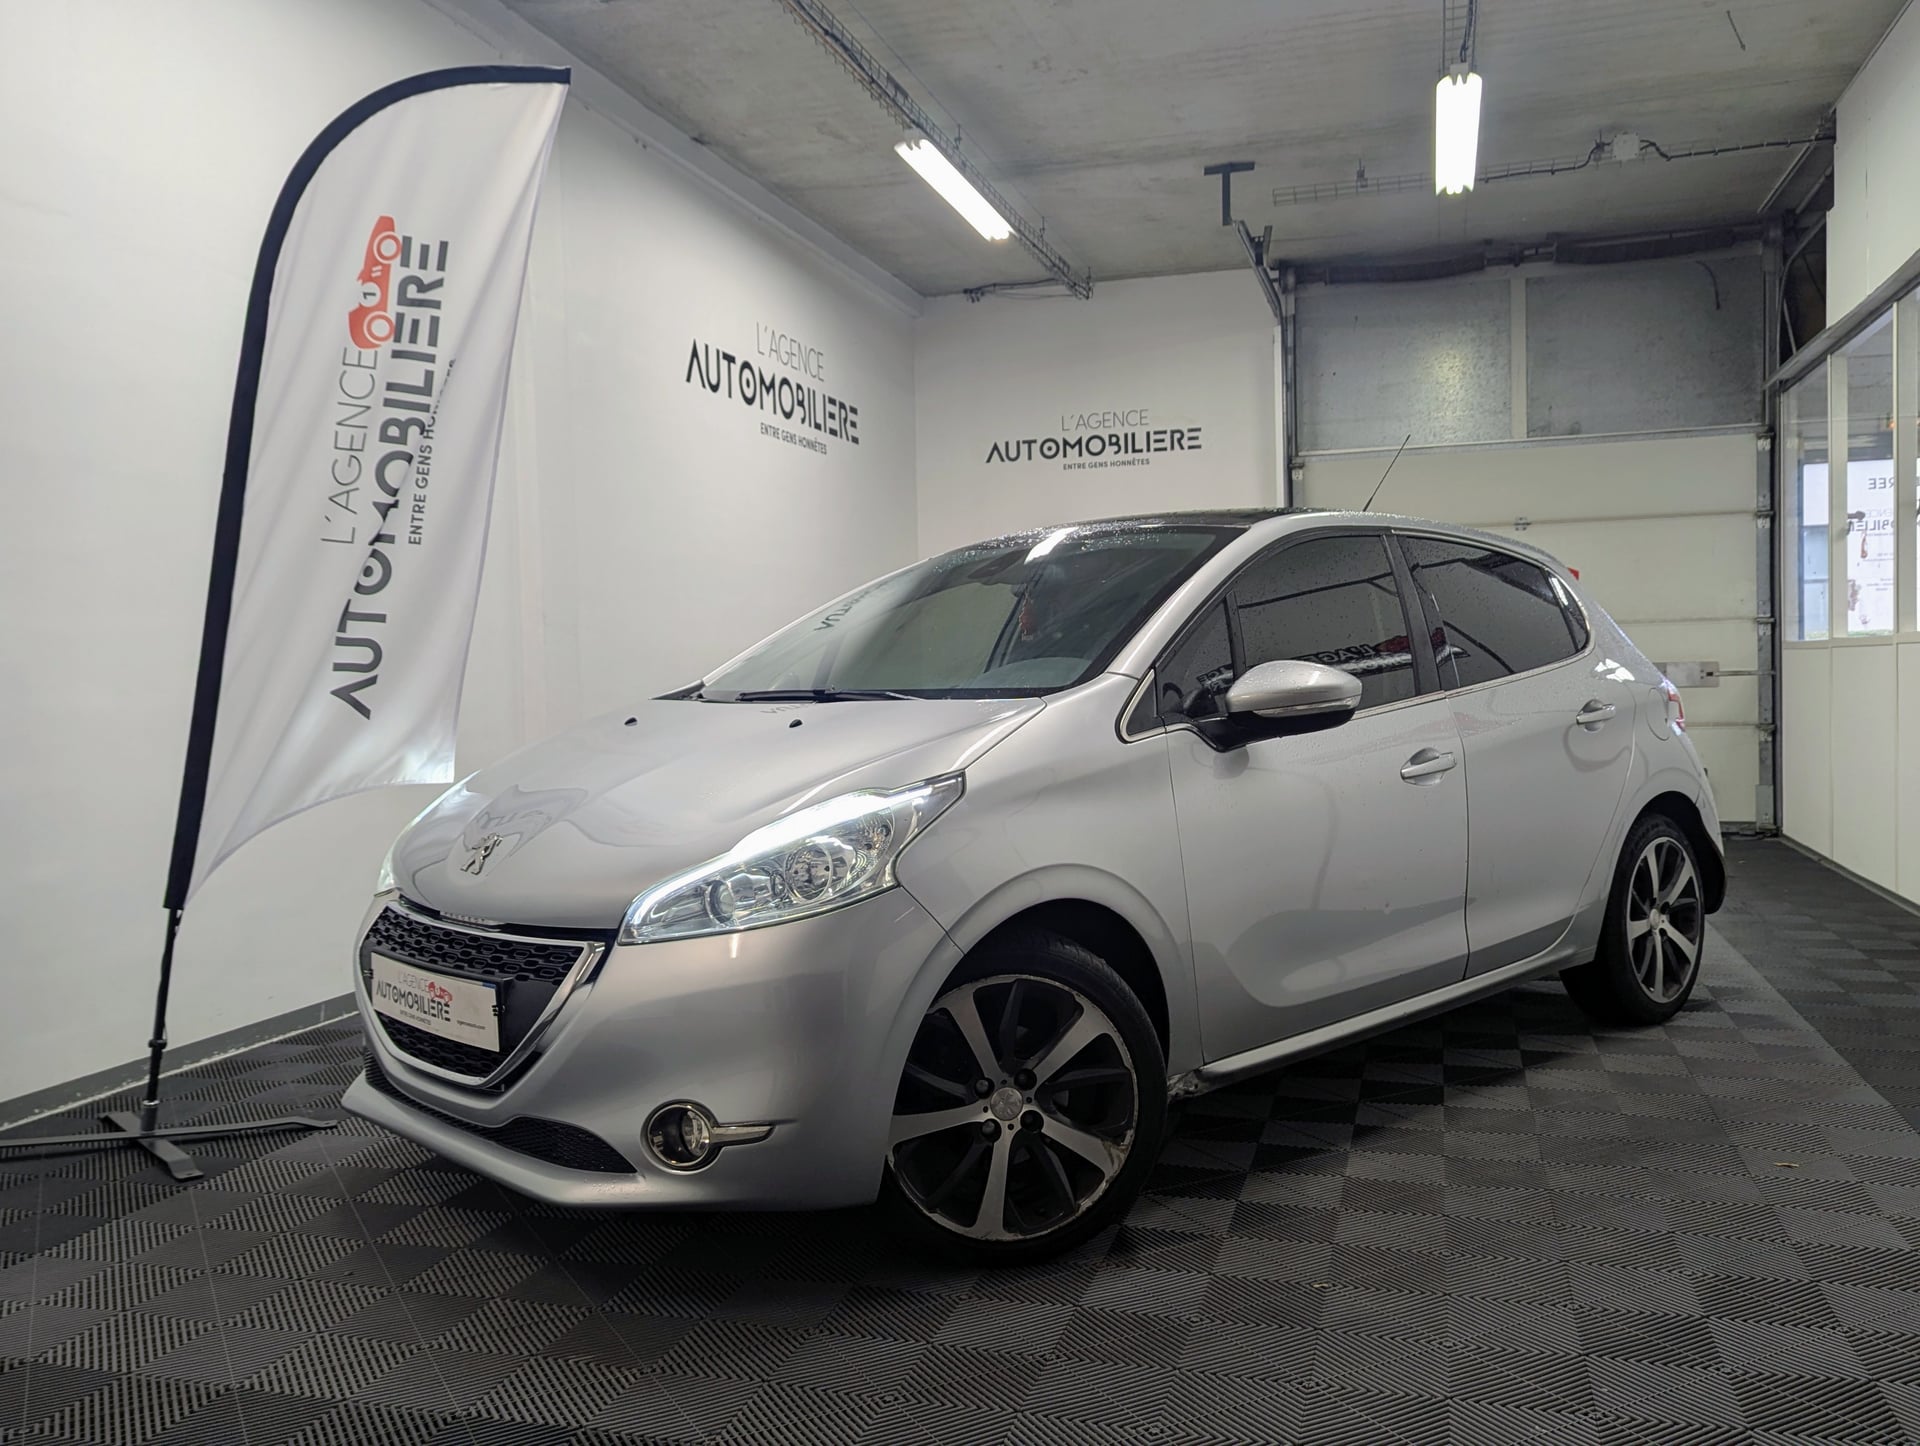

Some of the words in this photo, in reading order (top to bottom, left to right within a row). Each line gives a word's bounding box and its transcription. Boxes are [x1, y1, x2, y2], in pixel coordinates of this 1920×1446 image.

[756, 321, 825, 382] L'AGENCE
[685, 338, 860, 445] AUTOMOBILIERE
[760, 422, 780, 440] ENTRE
[781, 430, 797, 445] GENS
[1061, 408, 1149, 431] L'AGENCE
[321, 347, 378, 545] L'AGENCE
[415, 444, 433, 489] GENS
[985, 427, 1202, 463] AUTOMOBILIERE
[1063, 462, 1087, 470] ENTRE
[1088, 461, 1108, 469] GENS
[1110, 457, 1150, 467] HONNÊTES
[408, 494, 427, 546] ENTRE
[376, 979, 452, 1023] AUTOMOBILIERE
